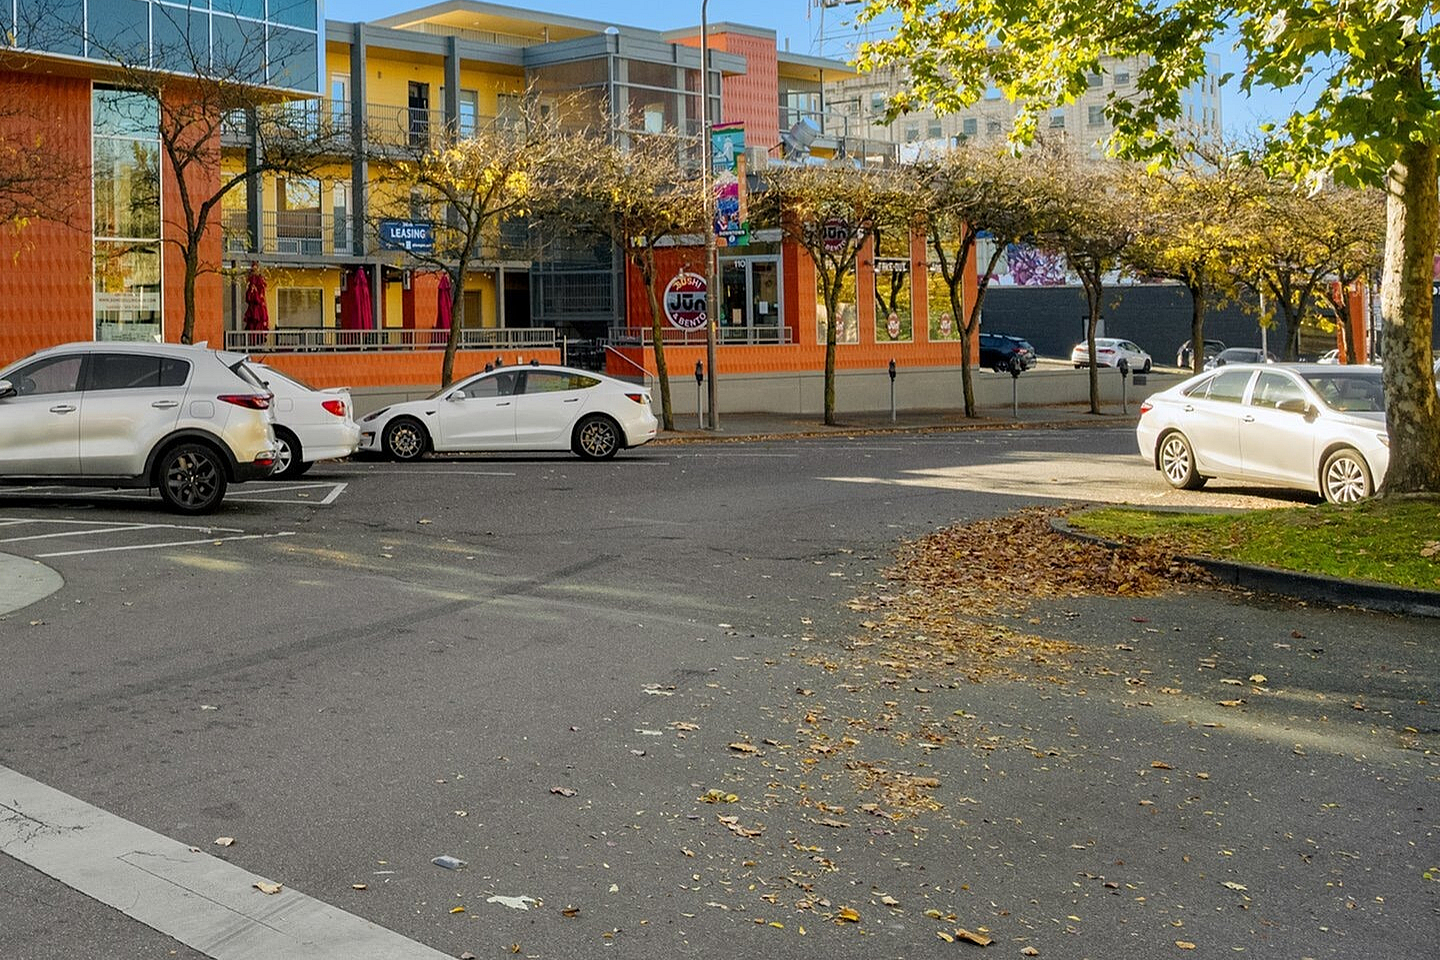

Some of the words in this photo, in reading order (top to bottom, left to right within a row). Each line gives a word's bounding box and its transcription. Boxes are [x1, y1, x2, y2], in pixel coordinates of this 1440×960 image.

[390, 228, 426, 239] LEASING
[734, 260, 746, 268] 110
[672, 312, 679, 320] &
[678, 312, 707, 327] BENTO
